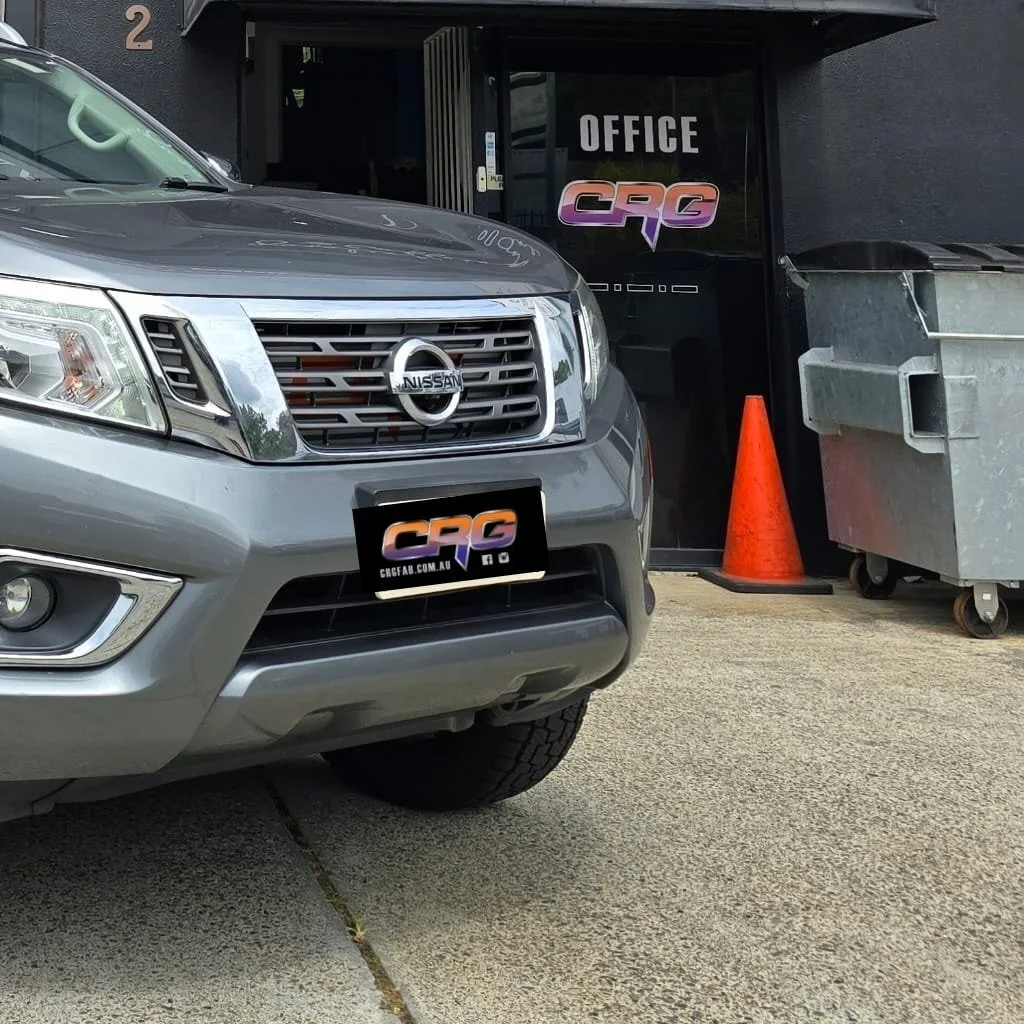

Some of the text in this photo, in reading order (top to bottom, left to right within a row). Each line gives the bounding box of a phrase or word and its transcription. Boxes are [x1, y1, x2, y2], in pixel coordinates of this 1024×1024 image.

[125, 4, 153, 50] 2
[579, 114, 699, 154] OFFICE
[557, 179, 721, 253] CRG
[401, 375, 462, 390] NISSAN
